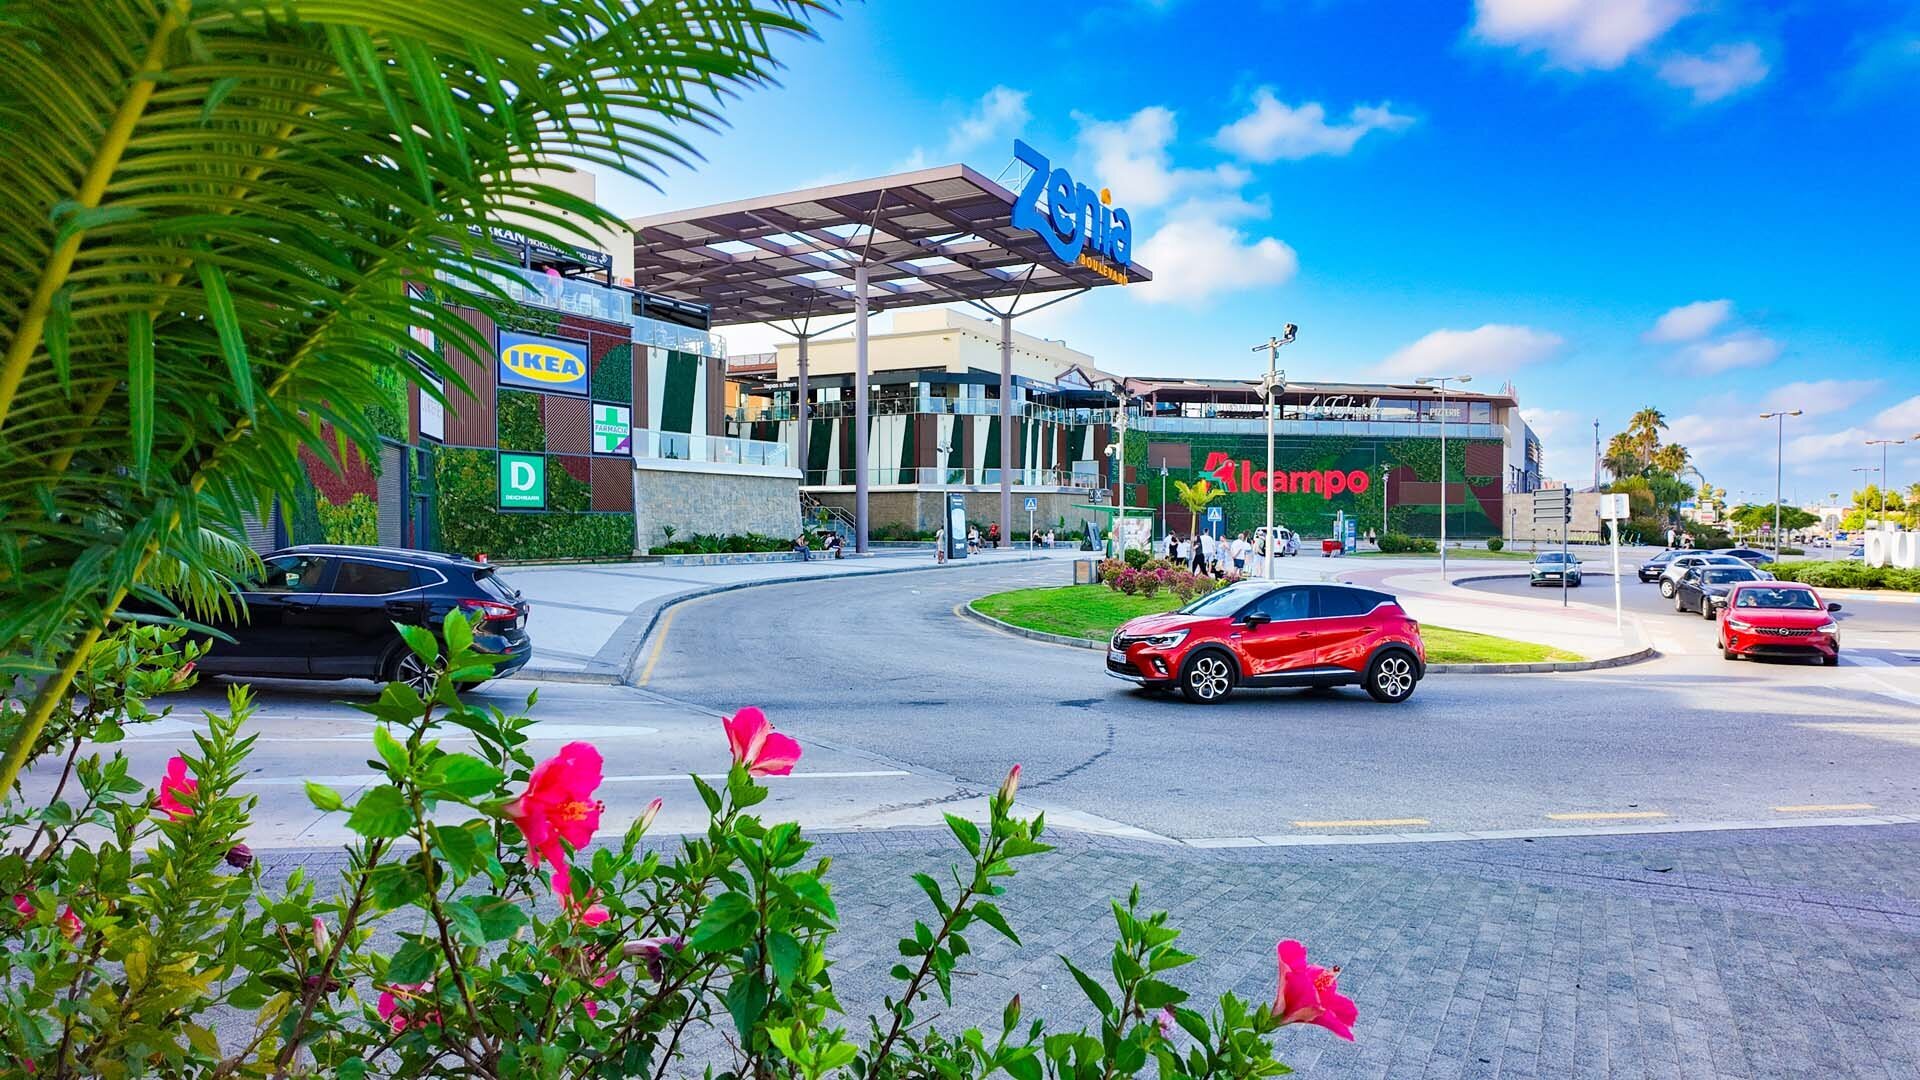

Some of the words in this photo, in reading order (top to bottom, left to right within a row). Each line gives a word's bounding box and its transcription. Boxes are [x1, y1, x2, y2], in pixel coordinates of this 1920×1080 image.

[1010, 138, 1132, 268] Zenia
[1078, 253, 1130, 286] BOULEVARD
[510, 350, 579, 377] IKEA
[594, 424, 628, 434] FARMACIA
[510, 461, 536, 491] D
[1198, 451, 1370, 500] Alcampo
